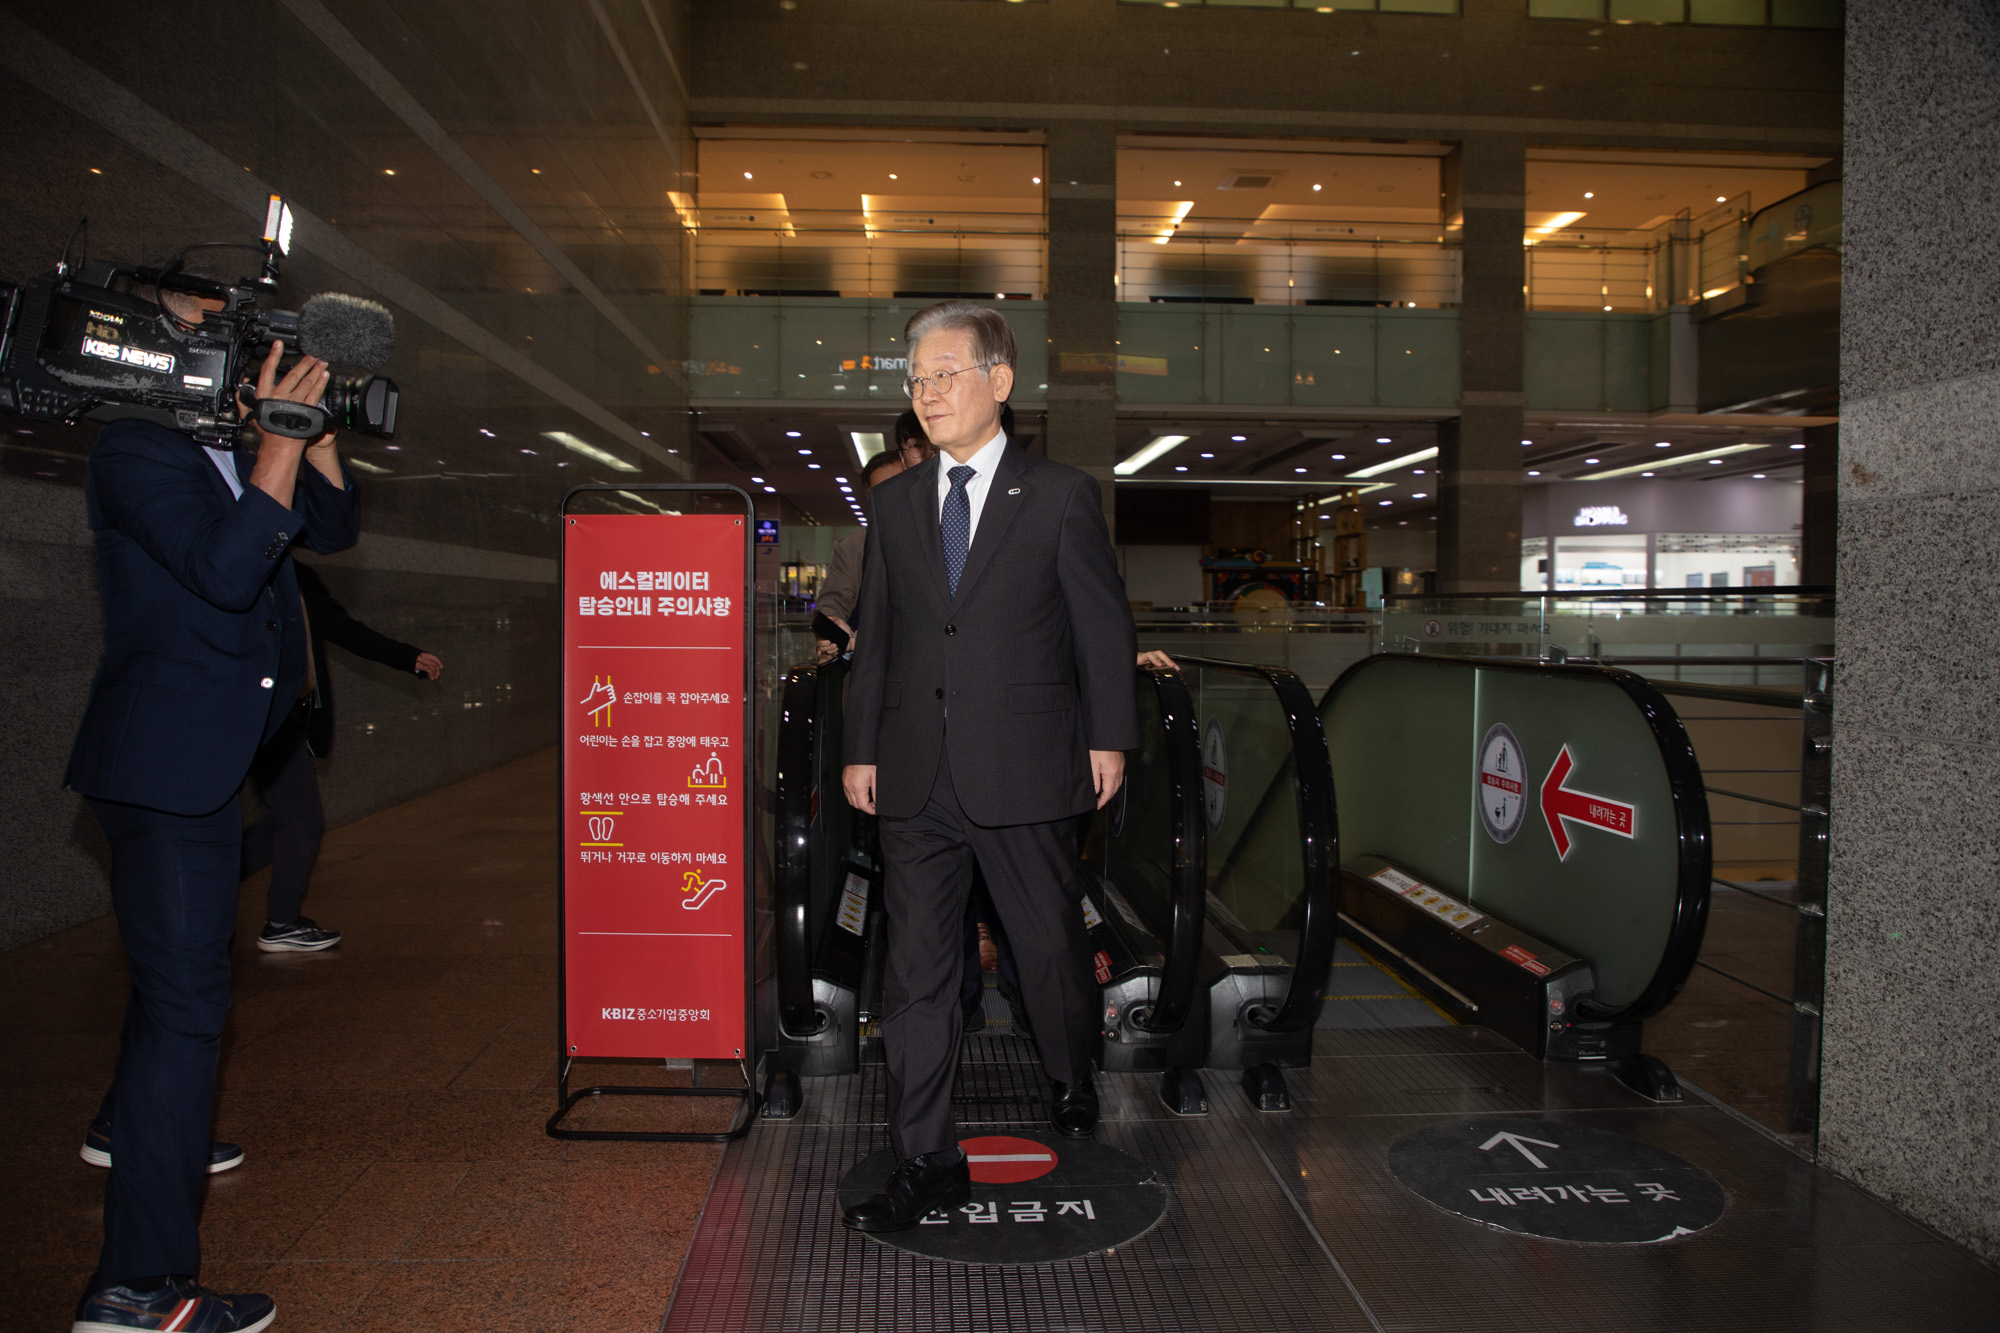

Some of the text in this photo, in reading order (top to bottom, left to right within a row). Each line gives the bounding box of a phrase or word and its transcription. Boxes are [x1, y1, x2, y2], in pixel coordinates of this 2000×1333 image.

[88, 310, 124, 325] XDCAM
[86, 321, 119, 340] HD
[85, 339, 171, 371] KBS NEWS
[188, 347, 217, 356] SONY
[599, 571, 709, 591] 에스컬레이터
[579, 596, 731, 617] 탑승안내 주의사항
[623, 691, 730, 705] 손잡이를 꼭 잡아주세요
[579, 734, 730, 749] 어린이는 손을 잡고 중앙에 태우고
[580, 791, 728, 807] 황색선 안으로 탑승해 주세요
[1589, 803, 1627, 828] 내려가는 곳
[580, 850, 728, 865] 뛰거나 거꾸로 이동하지 마세요
[1468, 1182, 1681, 1205] 내려가는 곳
